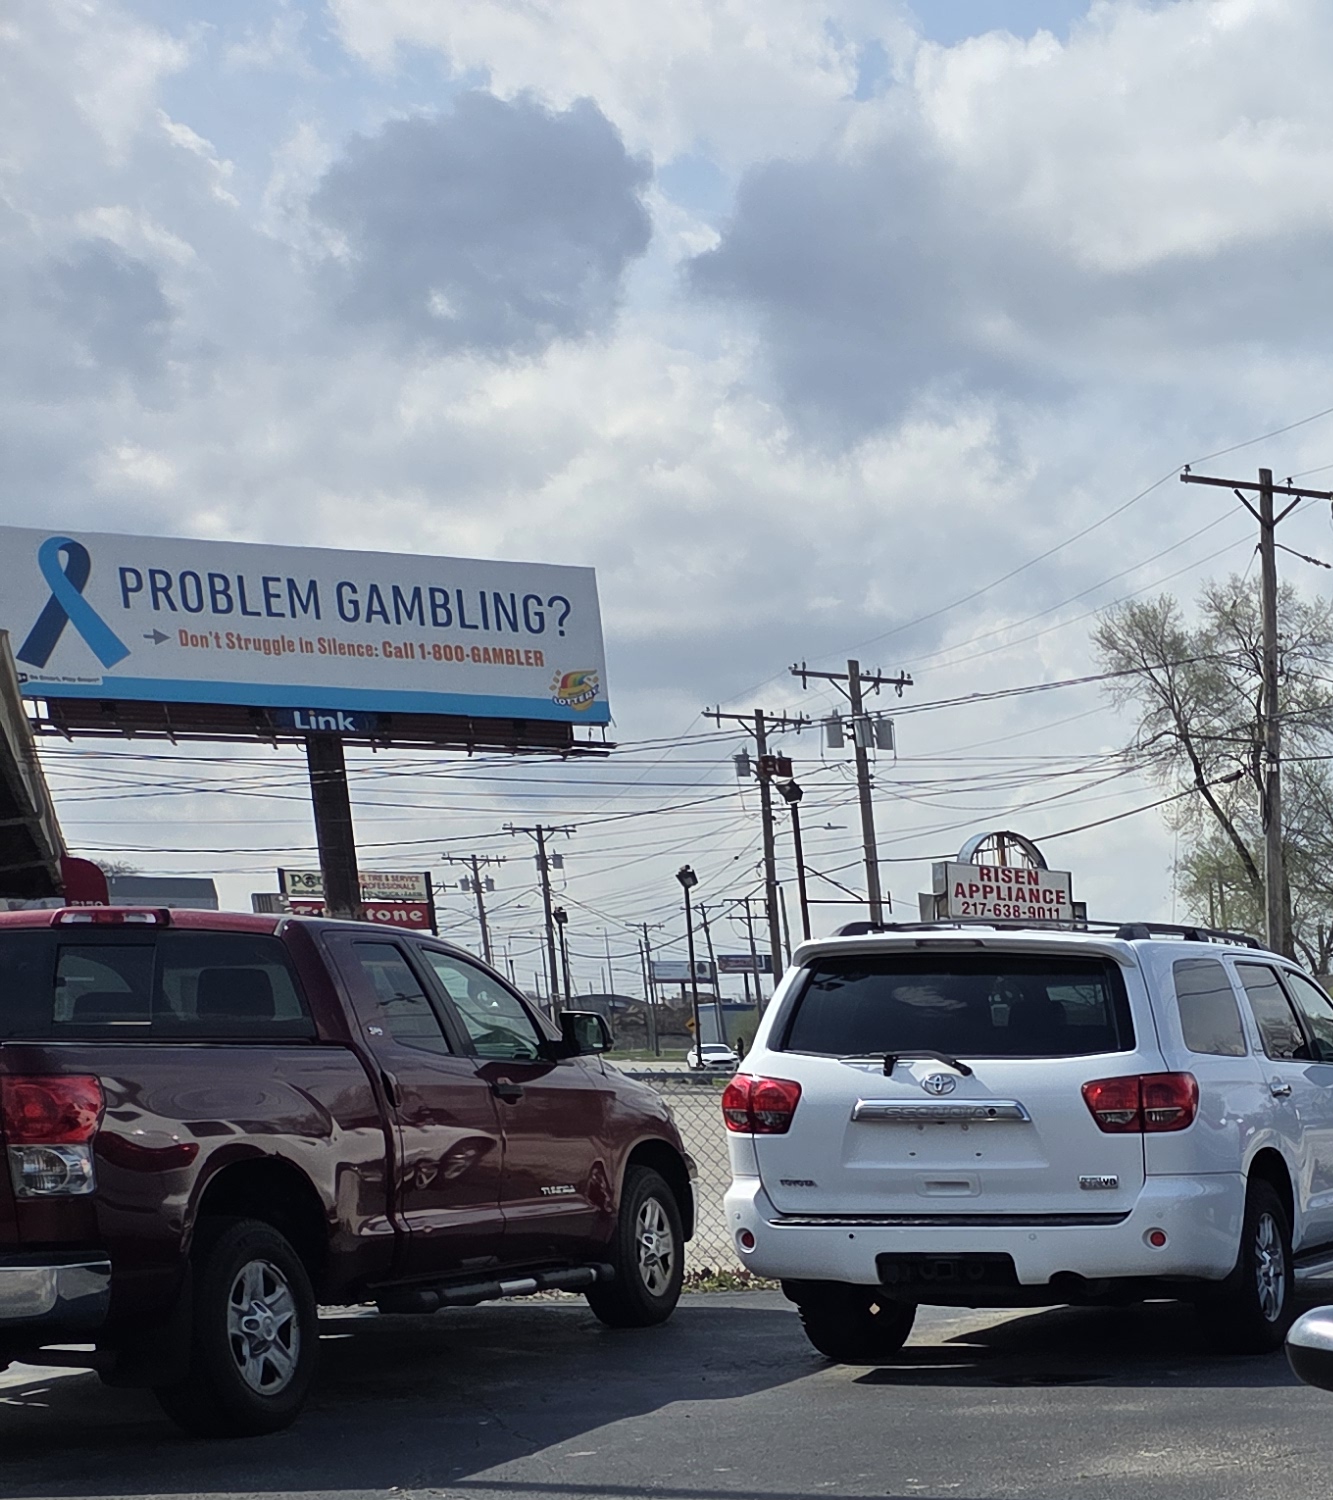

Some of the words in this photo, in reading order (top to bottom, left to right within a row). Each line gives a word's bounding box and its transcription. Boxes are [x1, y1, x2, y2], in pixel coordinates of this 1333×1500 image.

[118, 566, 322, 621] PROBLEM
[335, 580, 572, 638] GAMBLING?
[178, 628, 222, 650] Don't
[225, 631, 296, 657] Struggle
[299, 636, 314, 655] In
[317, 636, 380, 658] Silence:
[382, 640, 415, 661] Call
[418, 643, 545, 668] 1-800-GAMBLER
[553, 685, 599, 706] LOTTERY
[293, 709, 356, 732] Link
[391, 874, 420, 883] SERVICE
[979, 866, 1039, 886] RISEN
[954, 882, 1066, 906] APPLIANCE
[961, 901, 1060, 920] 217-638-9011
